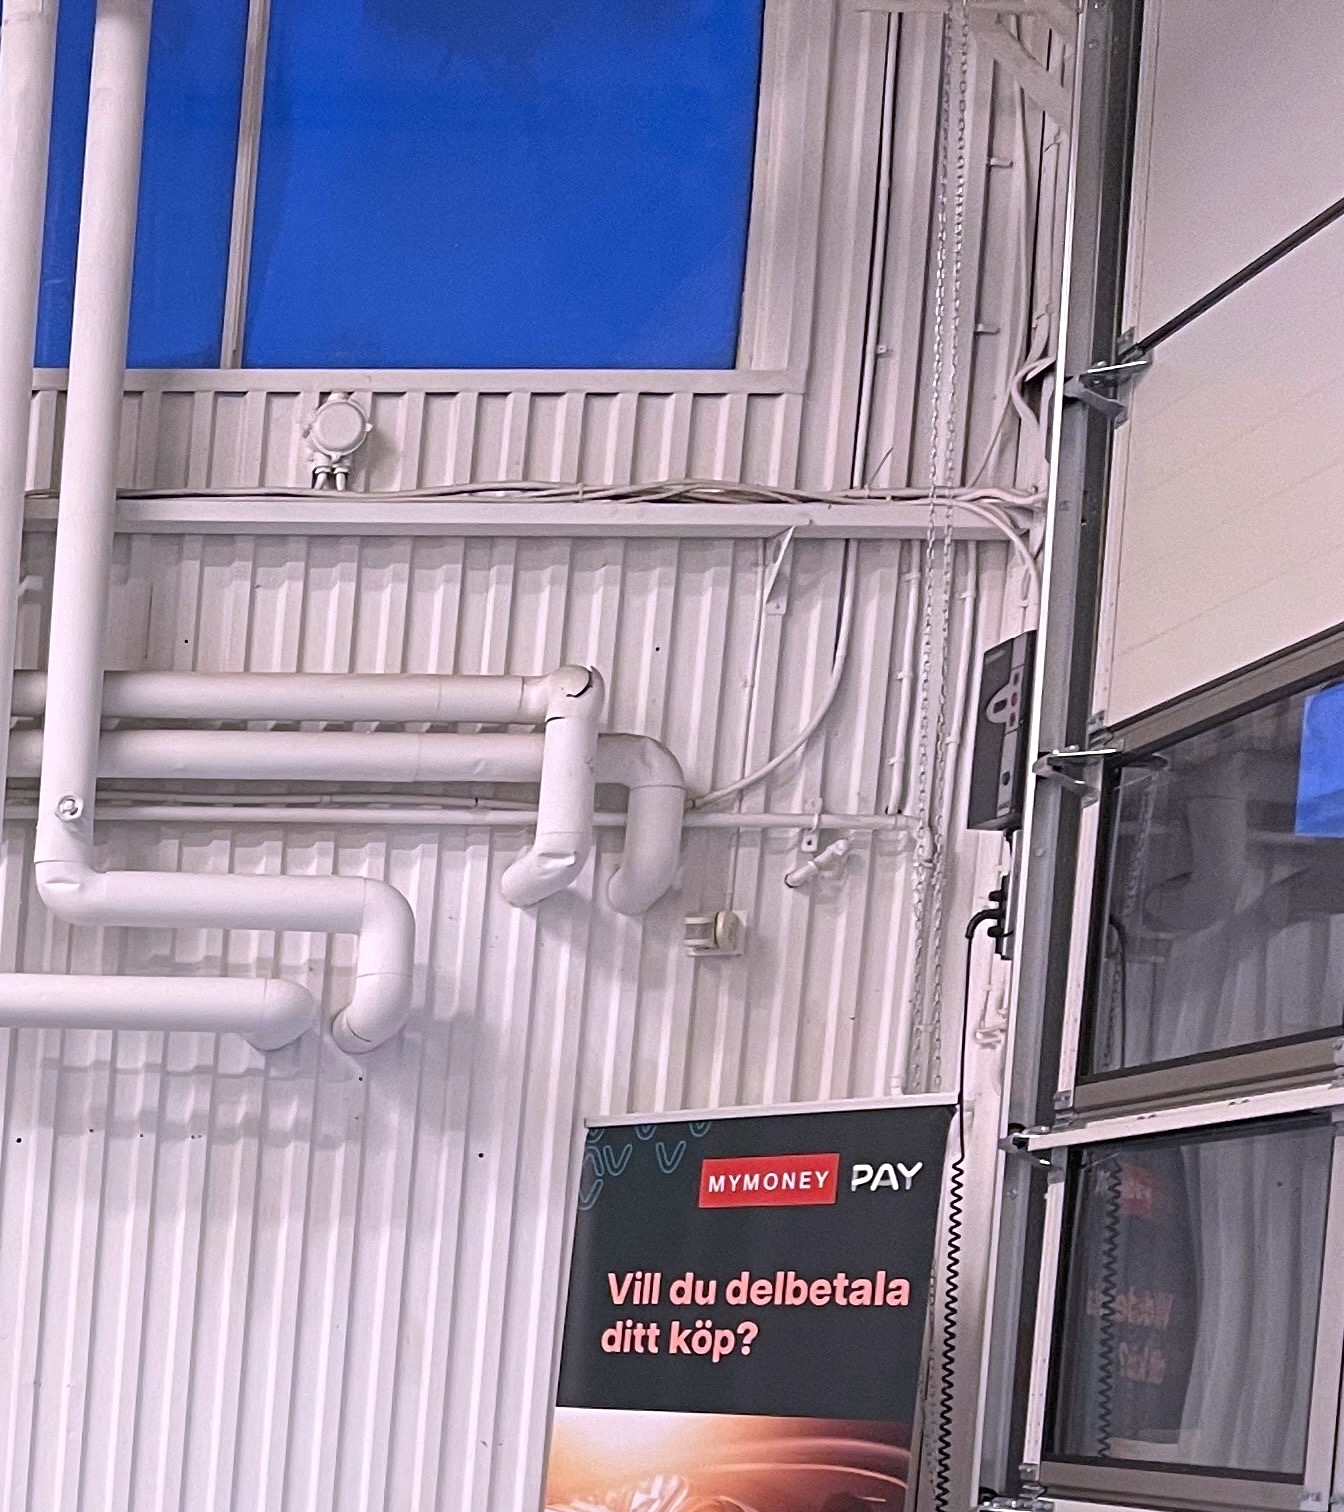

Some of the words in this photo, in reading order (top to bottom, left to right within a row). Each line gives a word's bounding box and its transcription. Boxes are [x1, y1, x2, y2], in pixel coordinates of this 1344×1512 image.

[707, 1170, 830, 1193] MYMONEY
[850, 1162, 923, 1192] PAY
[607, 1271, 662, 1305] Vill
[668, 1272, 716, 1306] du
[725, 1271, 911, 1307] delbetala
[601, 1320, 660, 1354] ditt
[669, 1319, 759, 1363] köp?
